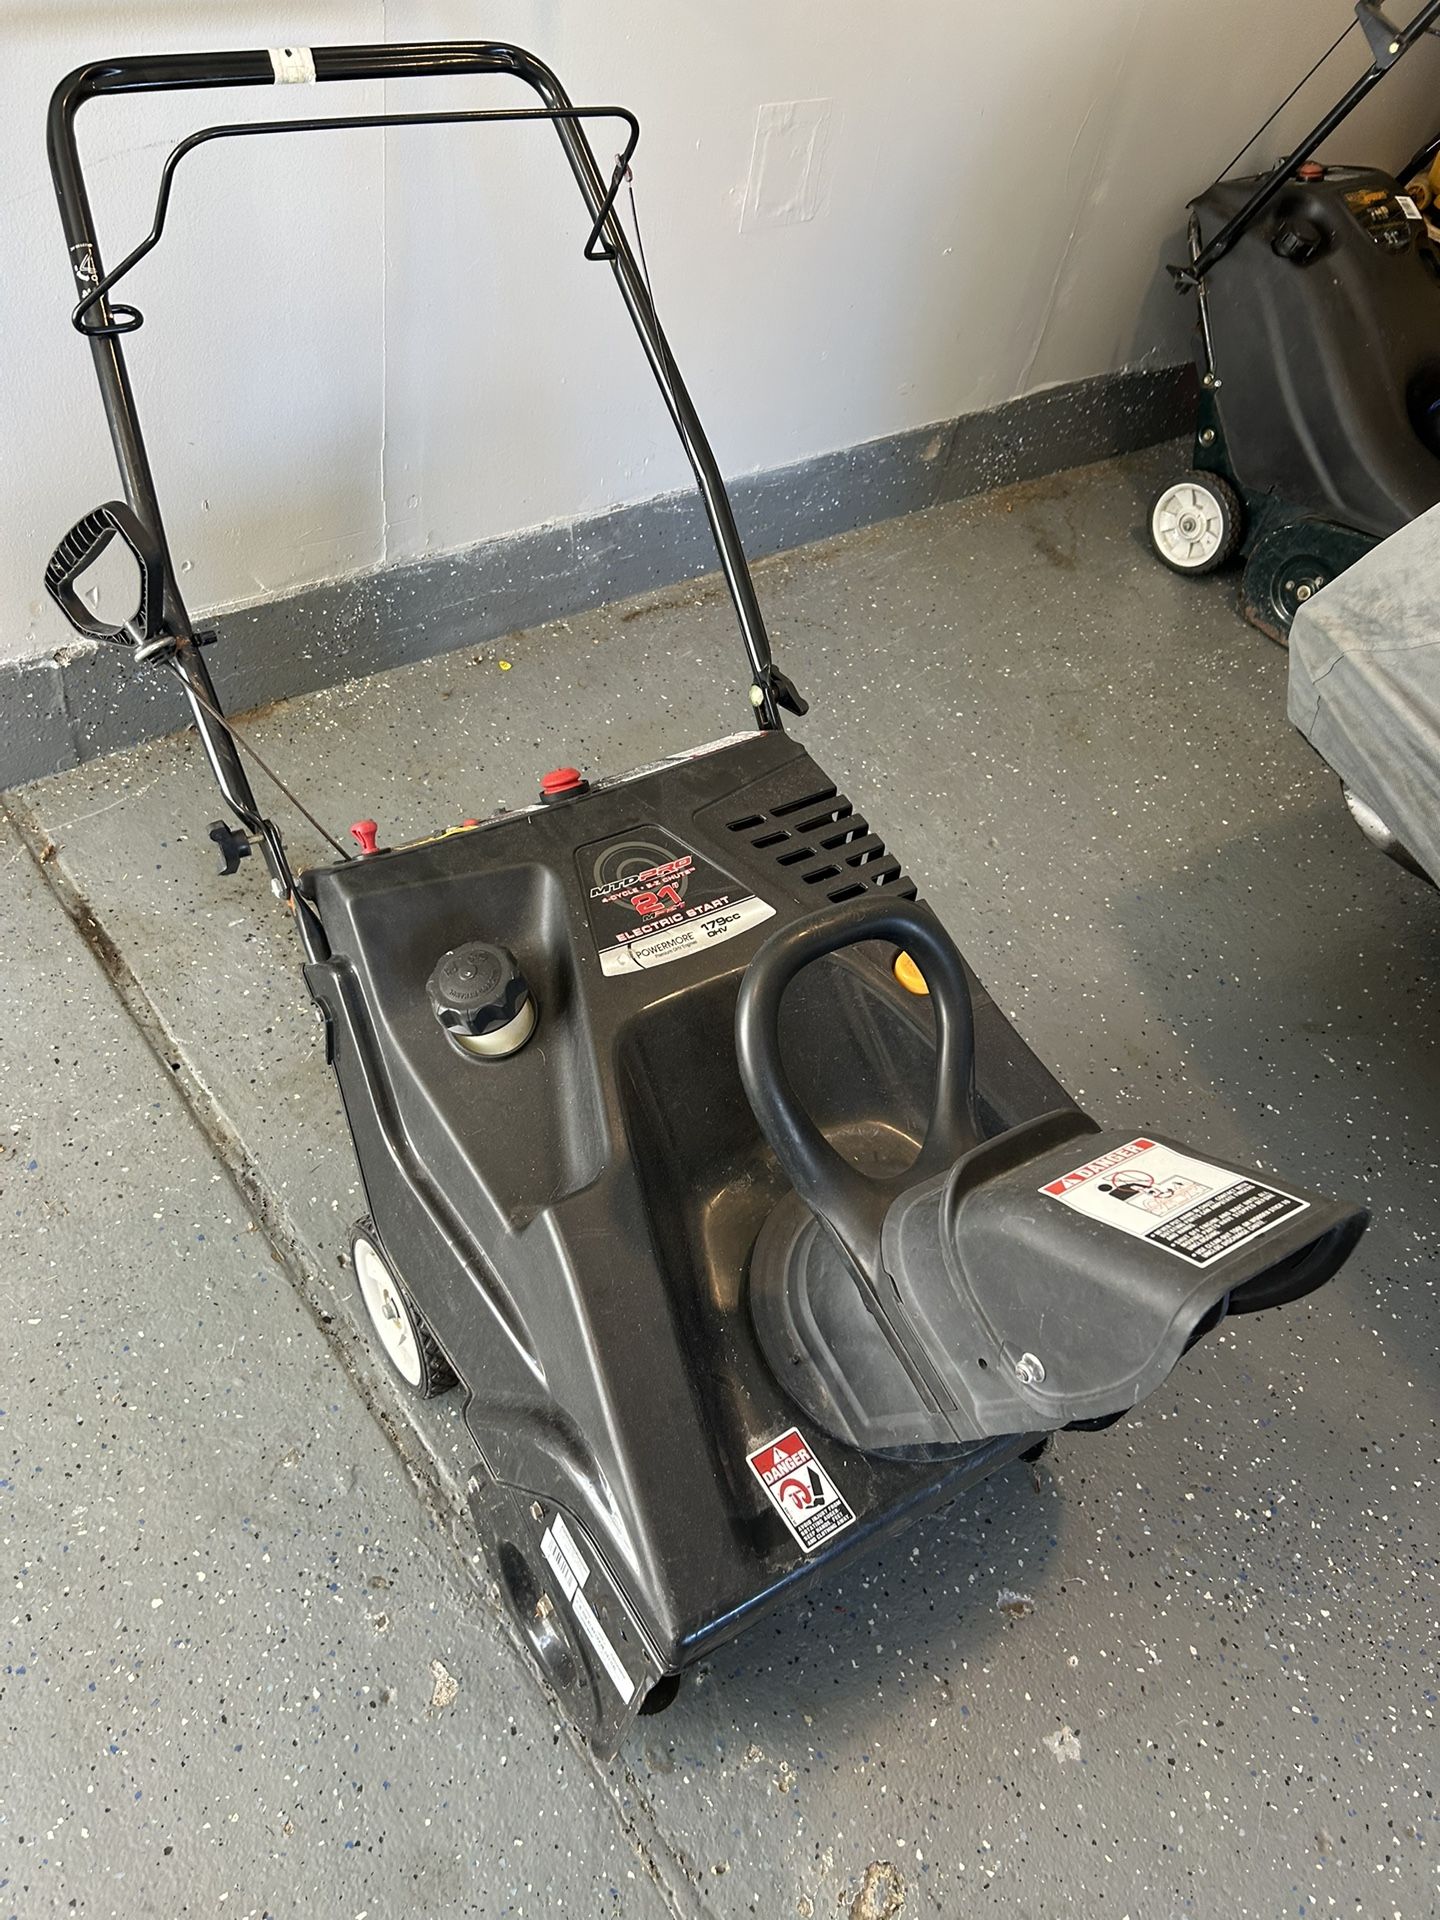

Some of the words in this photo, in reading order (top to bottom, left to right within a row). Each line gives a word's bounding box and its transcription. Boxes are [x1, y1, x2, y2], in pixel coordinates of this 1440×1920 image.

[601, 887, 639, 903] 4-CYCLE
[615, 912, 685, 943] ELECTRIC
[684, 895, 733, 917] START
[706, 925, 730, 937] OHV
[635, 931, 694, 959] POWERMORE
[699, 911, 742, 931] 179cc
[1073, 1143, 1144, 1178] DANGER
[761, 1447, 810, 1485] DANGER
[797, 1519, 812, 1531] AVOID
[811, 1508, 828, 1522] INJURY
[827, 1499, 841, 1511] FROM
[800, 1518, 823, 1536] ROTATING
[803, 1530, 816, 1541] KEEP
[831, 1511, 843, 1522] FEET
[806, 1536, 817, 1546] AND
[815, 1522, 837, 1539] CLOTHING
